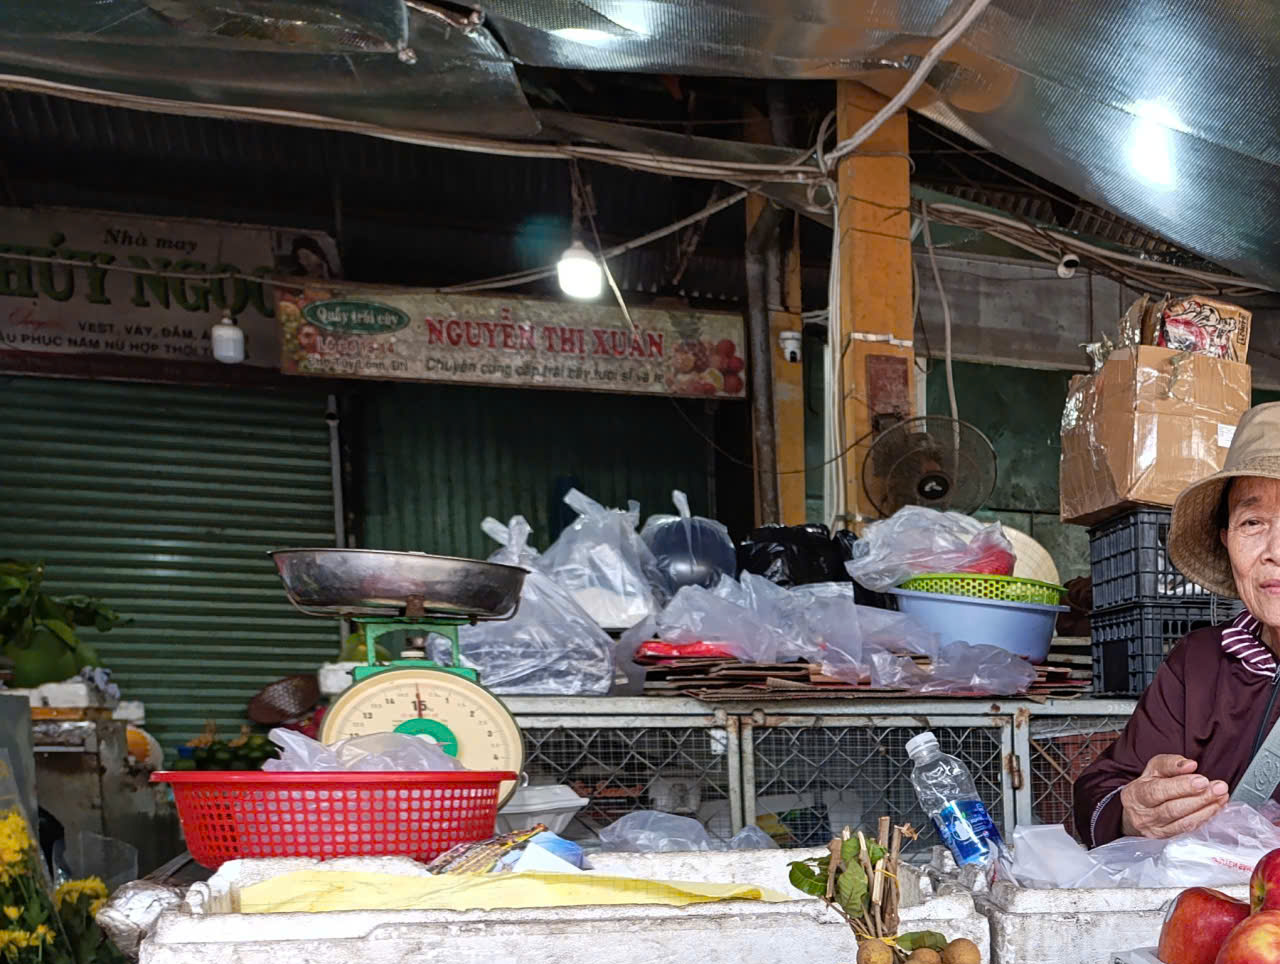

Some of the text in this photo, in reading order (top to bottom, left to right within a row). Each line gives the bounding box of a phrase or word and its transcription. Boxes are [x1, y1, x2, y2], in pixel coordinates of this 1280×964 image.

[103, 228, 198, 254] Nhà may
[425, 307, 537, 351] NGUYỄN
[543, 325, 585, 360] THỊ
